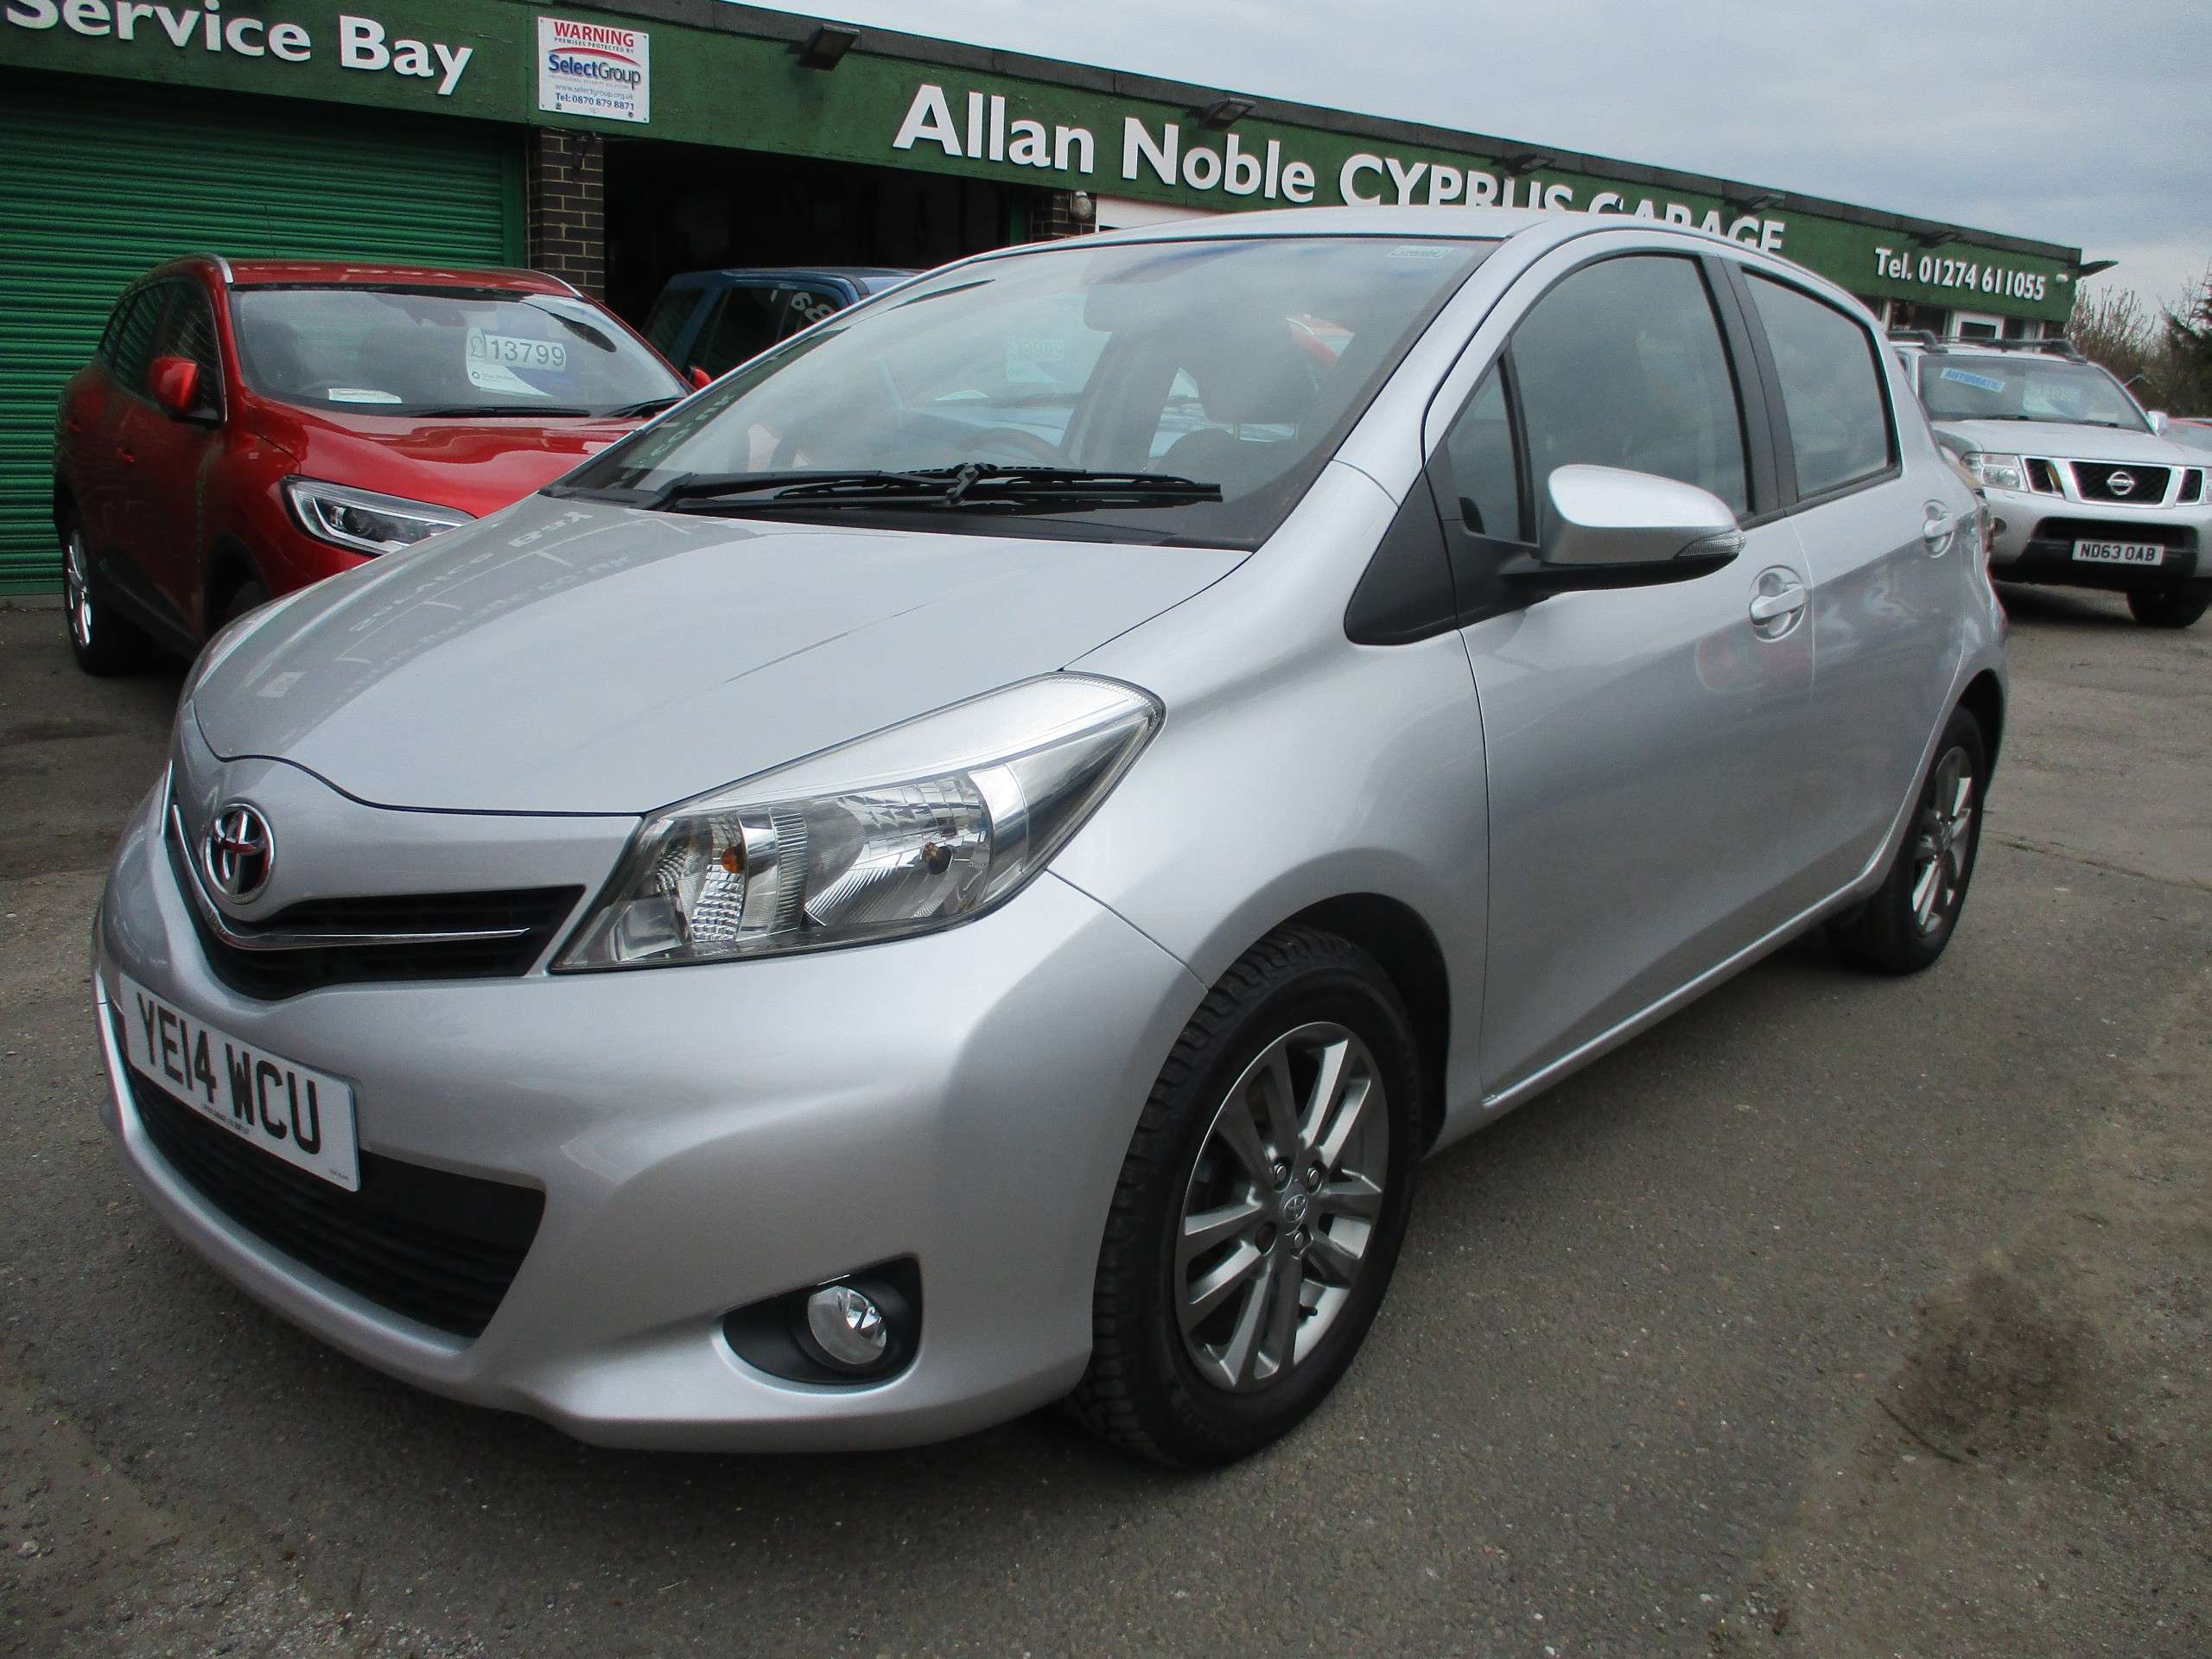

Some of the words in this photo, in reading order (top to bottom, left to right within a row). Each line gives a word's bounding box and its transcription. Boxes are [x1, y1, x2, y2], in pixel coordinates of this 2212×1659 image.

[5, 0, 312, 62] Service
[338, 14, 474, 96] Bay
[554, 22, 634, 48] WARNING
[554, 37, 587, 47] PREMISES
[588, 41, 625, 53] PROTECTED
[548, 54, 641, 91] SelectGroup
[556, 92, 571, 103] Tel:
[571, 94, 594, 105] 0870
[595, 98, 613, 109] 879
[613, 100, 635, 111] 8871
[892, 83, 1095, 175] Allan
[1122, 116, 1316, 204] Noble
[1338, 153, 1574, 212] CYPRUS
[1874, 247, 1912, 281] Tel.
[1917, 255, 1977, 290] 01274
[1980, 266, 2046, 302] 611055
[2124, 545, 2156, 562] OAB
[137, 992, 217, 1104] YE14
[225, 1042, 321, 1155] WCU
